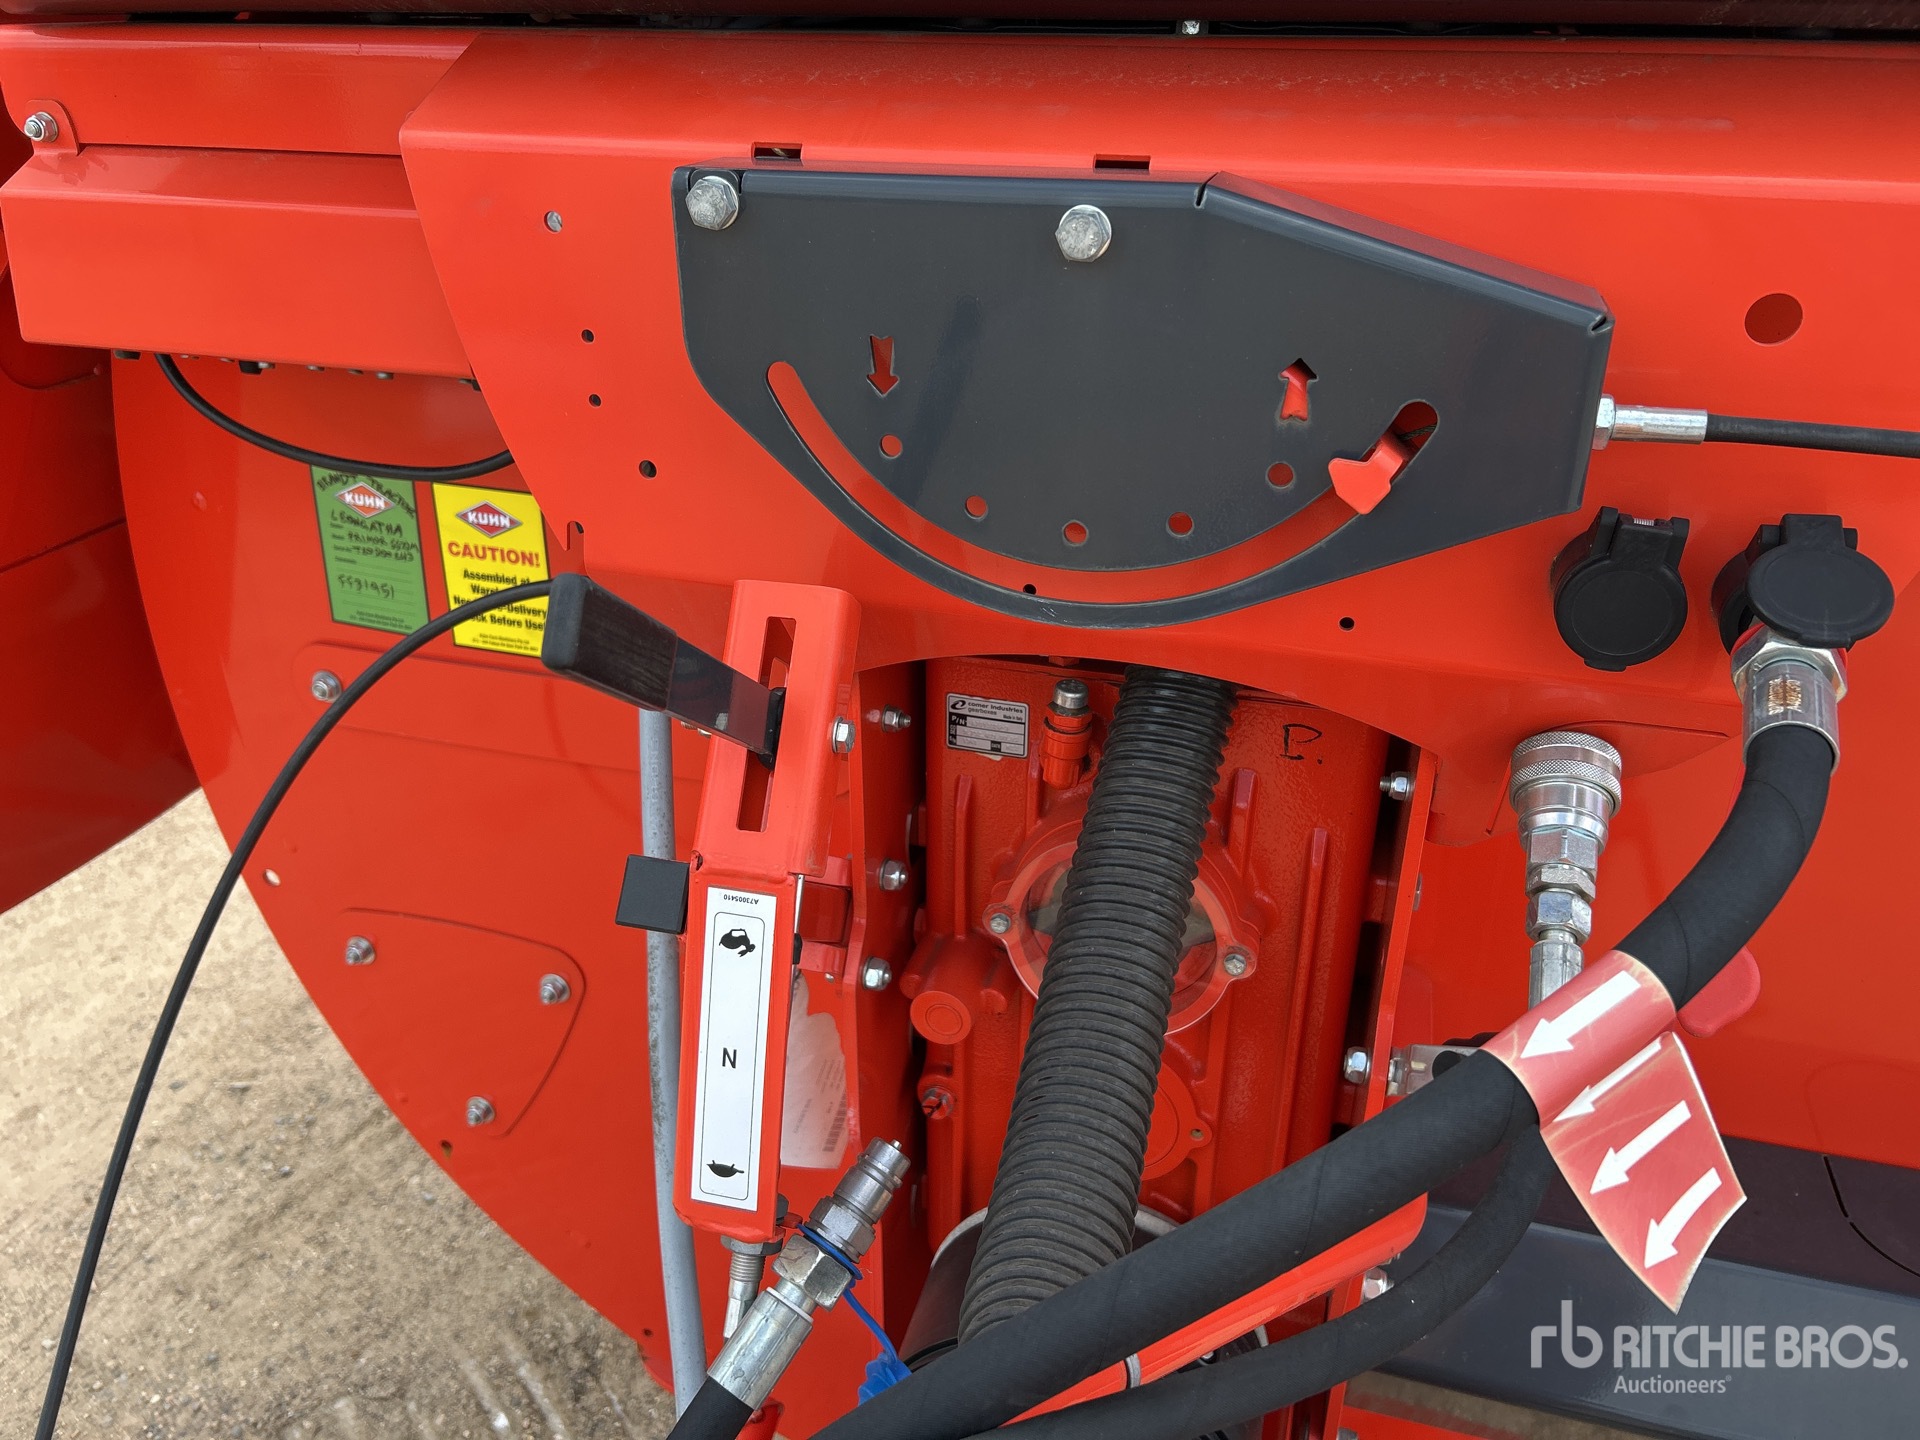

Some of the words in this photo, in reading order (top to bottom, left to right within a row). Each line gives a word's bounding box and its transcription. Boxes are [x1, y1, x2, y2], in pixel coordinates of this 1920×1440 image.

[344, 491, 385, 510] KUHN
[467, 511, 511, 528] KUHN
[447, 541, 541, 568] CAUTION!
[463, 569, 517, 585] Assembled
[489, 614, 522, 629] Before
[968, 701, 989, 709] comer
[990, 704, 1023, 714] industries
[968, 707, 997, 716] gearboxes
[723, 894, 759, 904] A73005410
